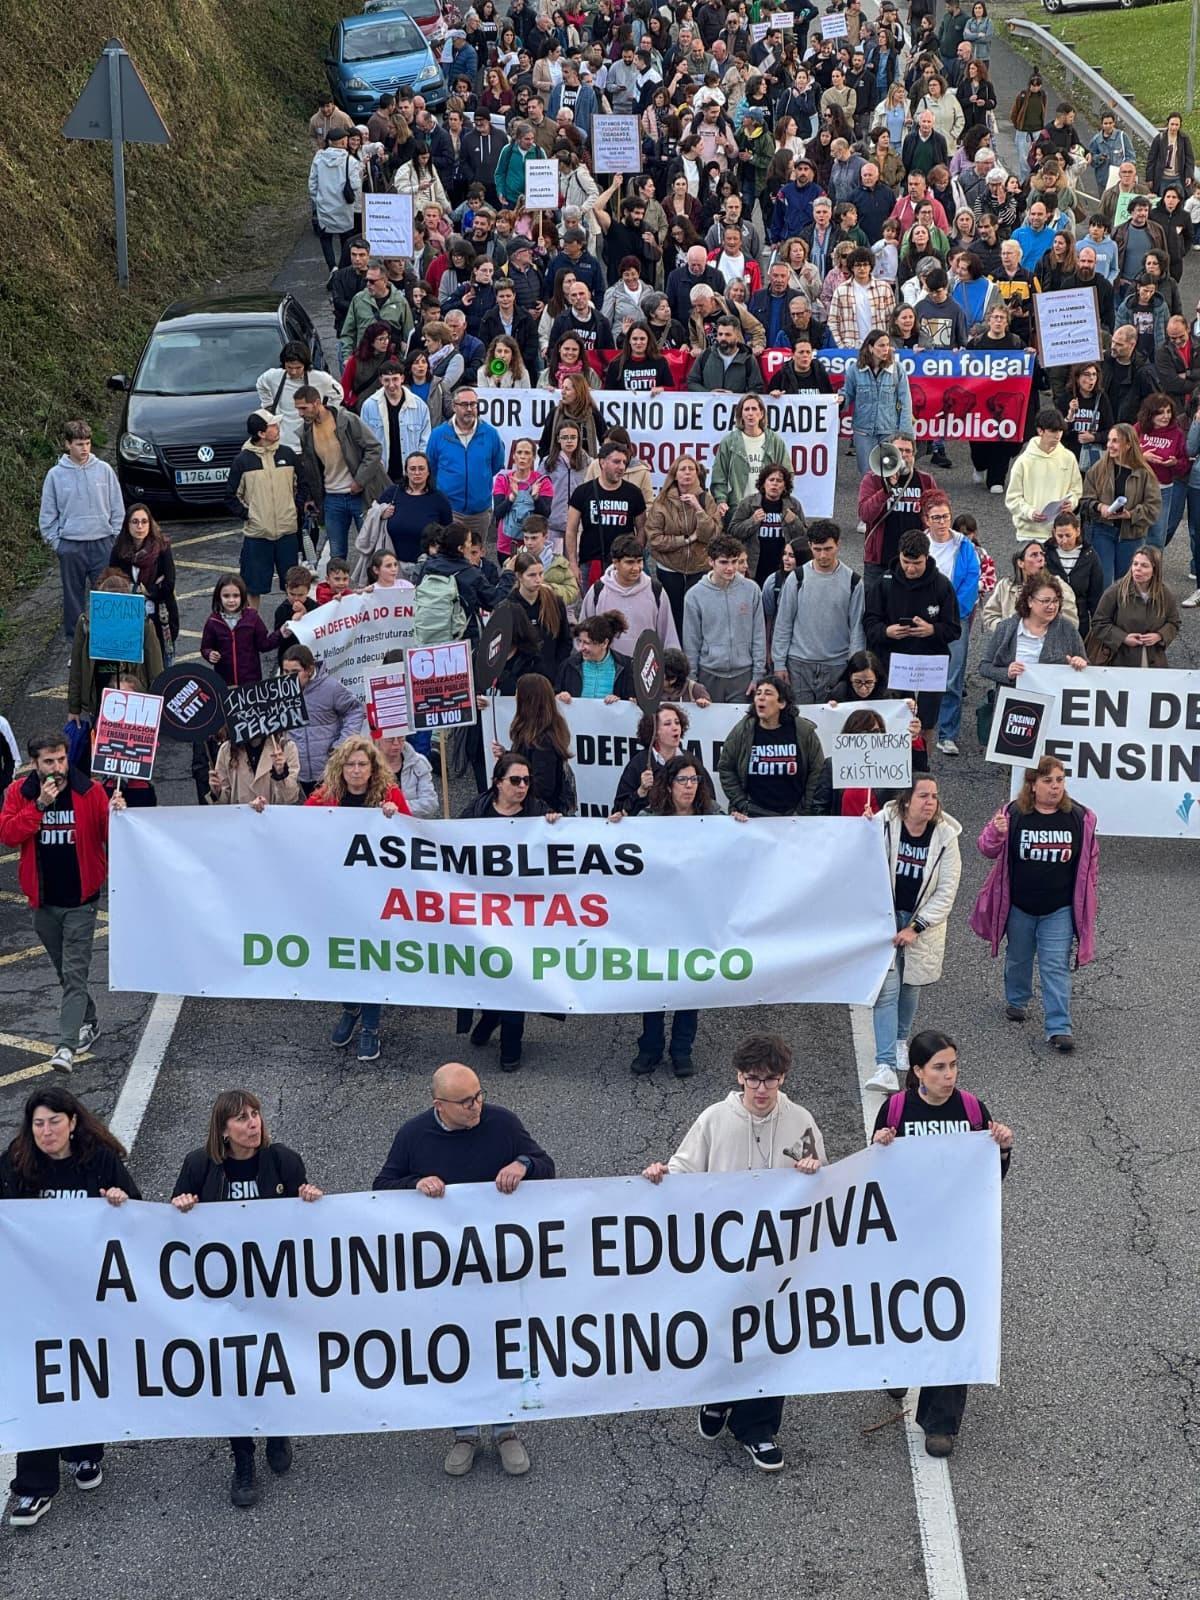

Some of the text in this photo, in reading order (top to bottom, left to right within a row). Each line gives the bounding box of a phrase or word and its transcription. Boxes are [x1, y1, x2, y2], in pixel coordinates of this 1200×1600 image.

[623, 368, 657, 377] ENSINO
[922, 358, 953, 376] en
[959, 353, 1031, 382] folga!
[476, 398, 522, 427] POR
[674, 402, 703, 431] DE
[184, 471, 212, 482] 1764
[313, 625, 327, 640] EN
[328, 610, 371, 639] DEFENSA
[373, 606, 389, 620] DO
[410, 644, 468, 680] 6M
[102, 691, 161, 728] 6M
[166, 679, 200, 713] ENSINO
[177, 690, 211, 724] LOITA
[224, 674, 301, 716] INCLUSIÓN
[1060, 688, 1129, 728] EN
[425, 709, 462, 726] EU VOU
[1005, 722, 1033, 737] LOITA
[1008, 712, 1037, 727] ENSINO
[751, 743, 797, 757] ENSINO
[834, 733, 910, 751] SOMOS DIVERSAS
[103, 757, 141, 775] EU VOU
[748, 761, 797, 776] LOITO
[1020, 829, 1073, 844] ENSINO
[343, 833, 645, 877] ASEMBLEAS
[1019, 847, 1073, 863] LOITO
[380, 887, 609, 927] ABERTAS
[243, 933, 754, 981] DO ENSINO PÚBLICO
[96, 1181, 898, 1302] A COMUNIDADE EDUCATIVA
[34, 1276, 966, 1404] EN LOITA POLO ENSINO PÚBLICO
